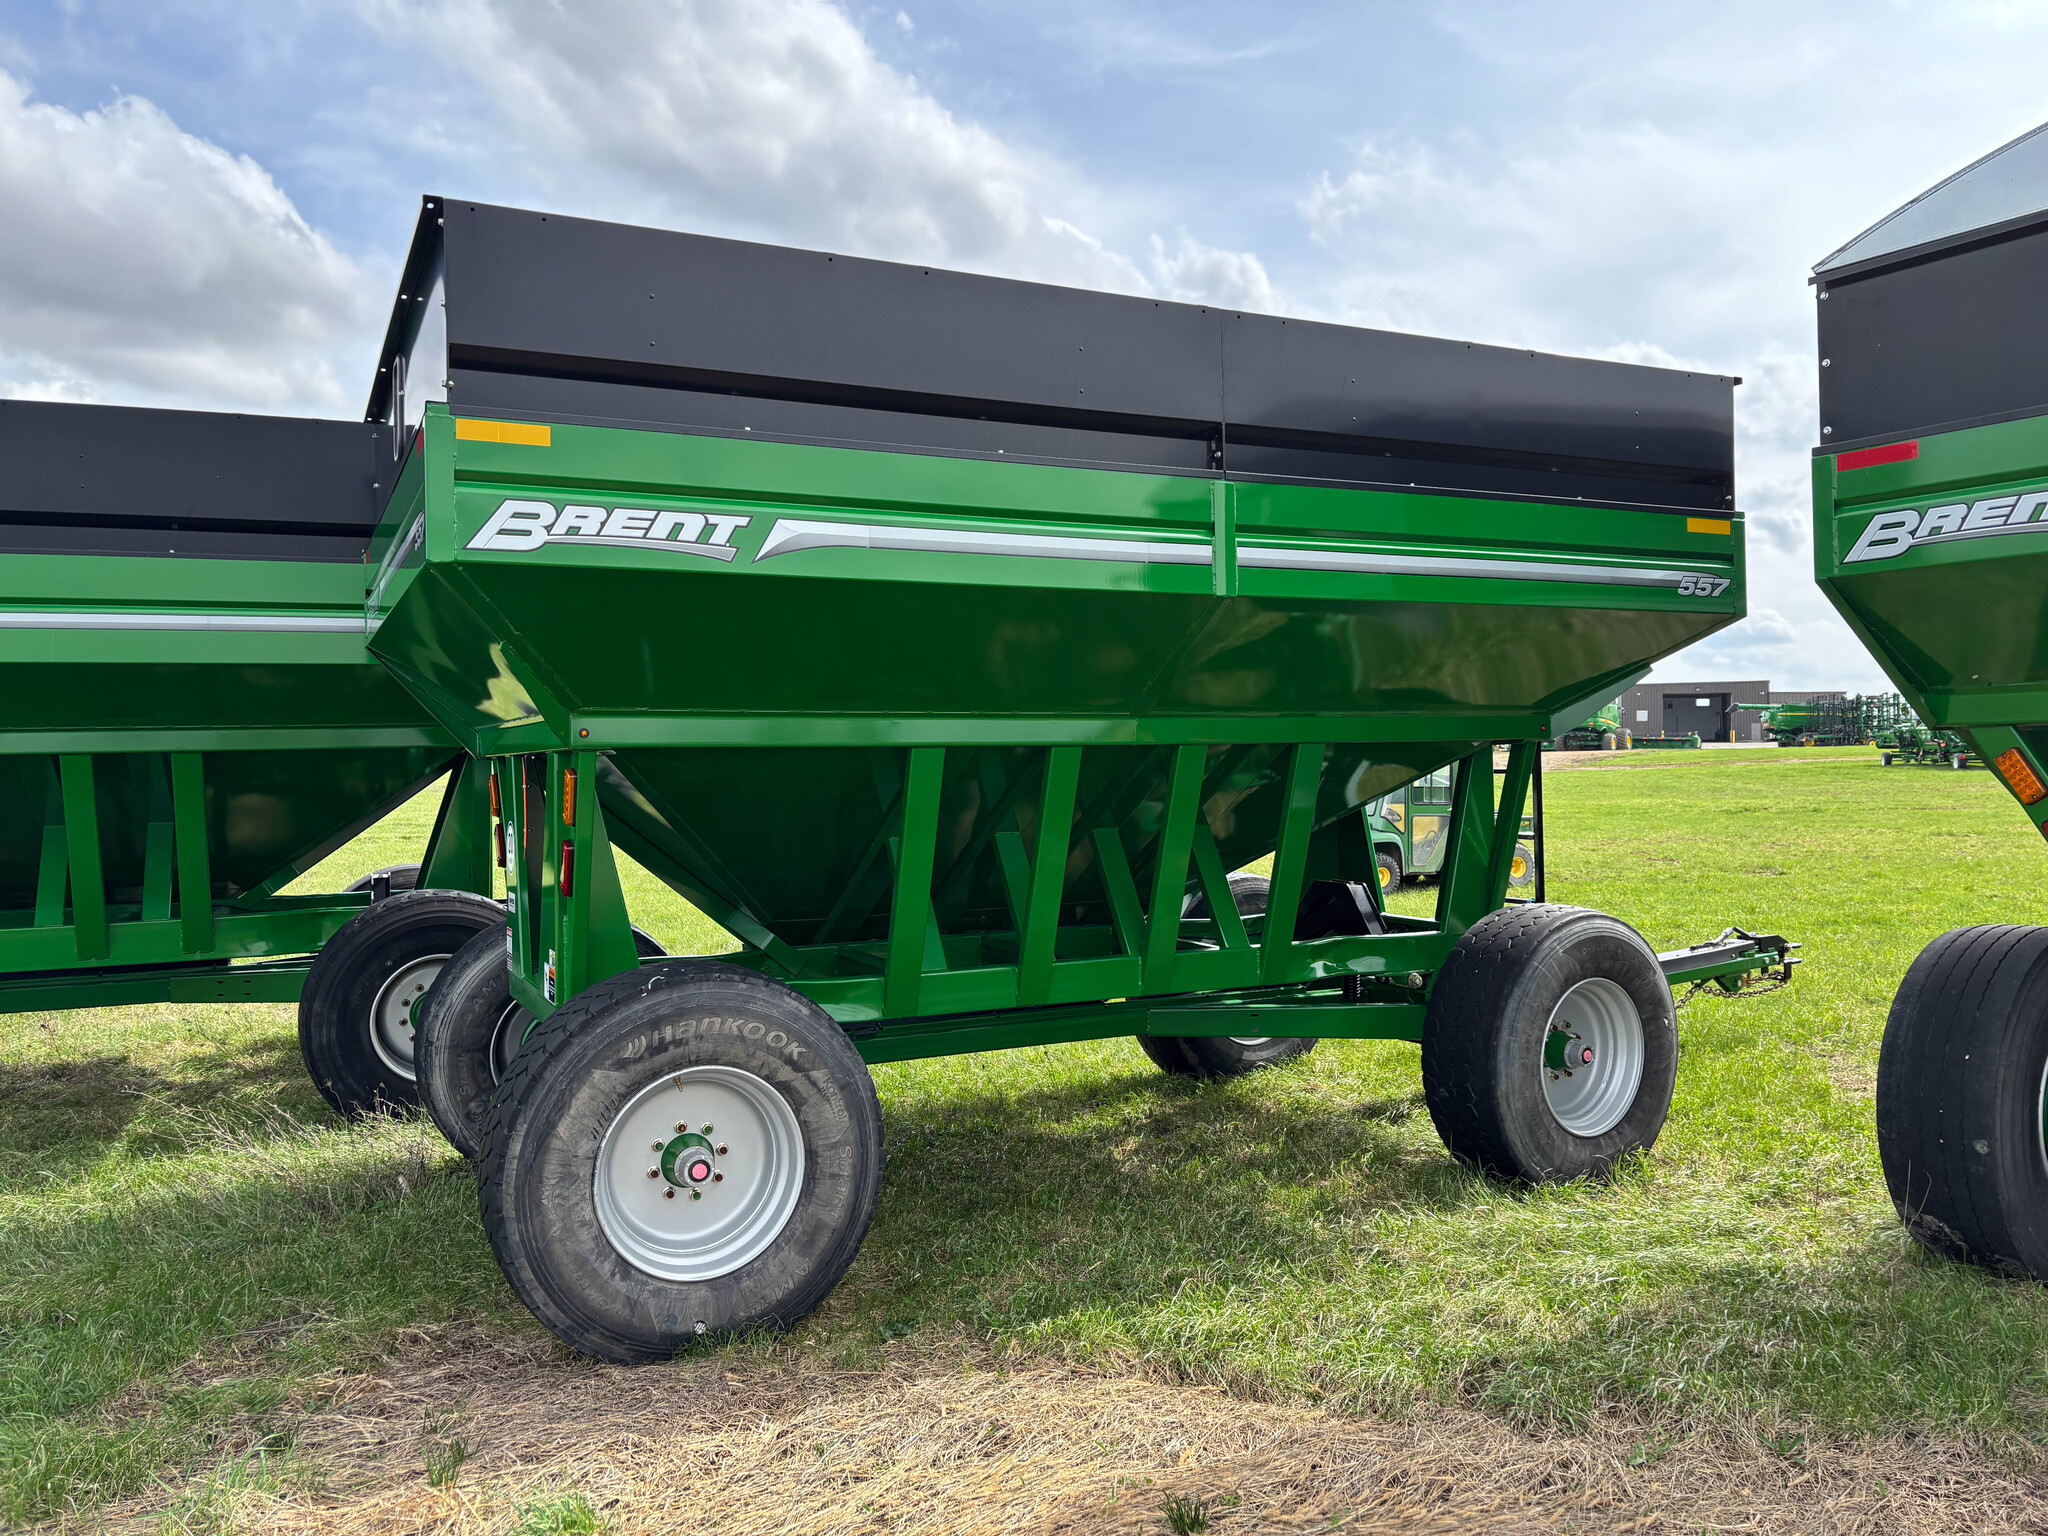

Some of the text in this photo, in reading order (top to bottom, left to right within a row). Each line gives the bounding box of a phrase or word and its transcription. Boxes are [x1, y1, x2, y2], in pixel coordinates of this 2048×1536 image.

[464, 498, 754, 556] BRENT
[1841, 491, 2048, 565] BREN
[1677, 575, 1732, 598] 557
